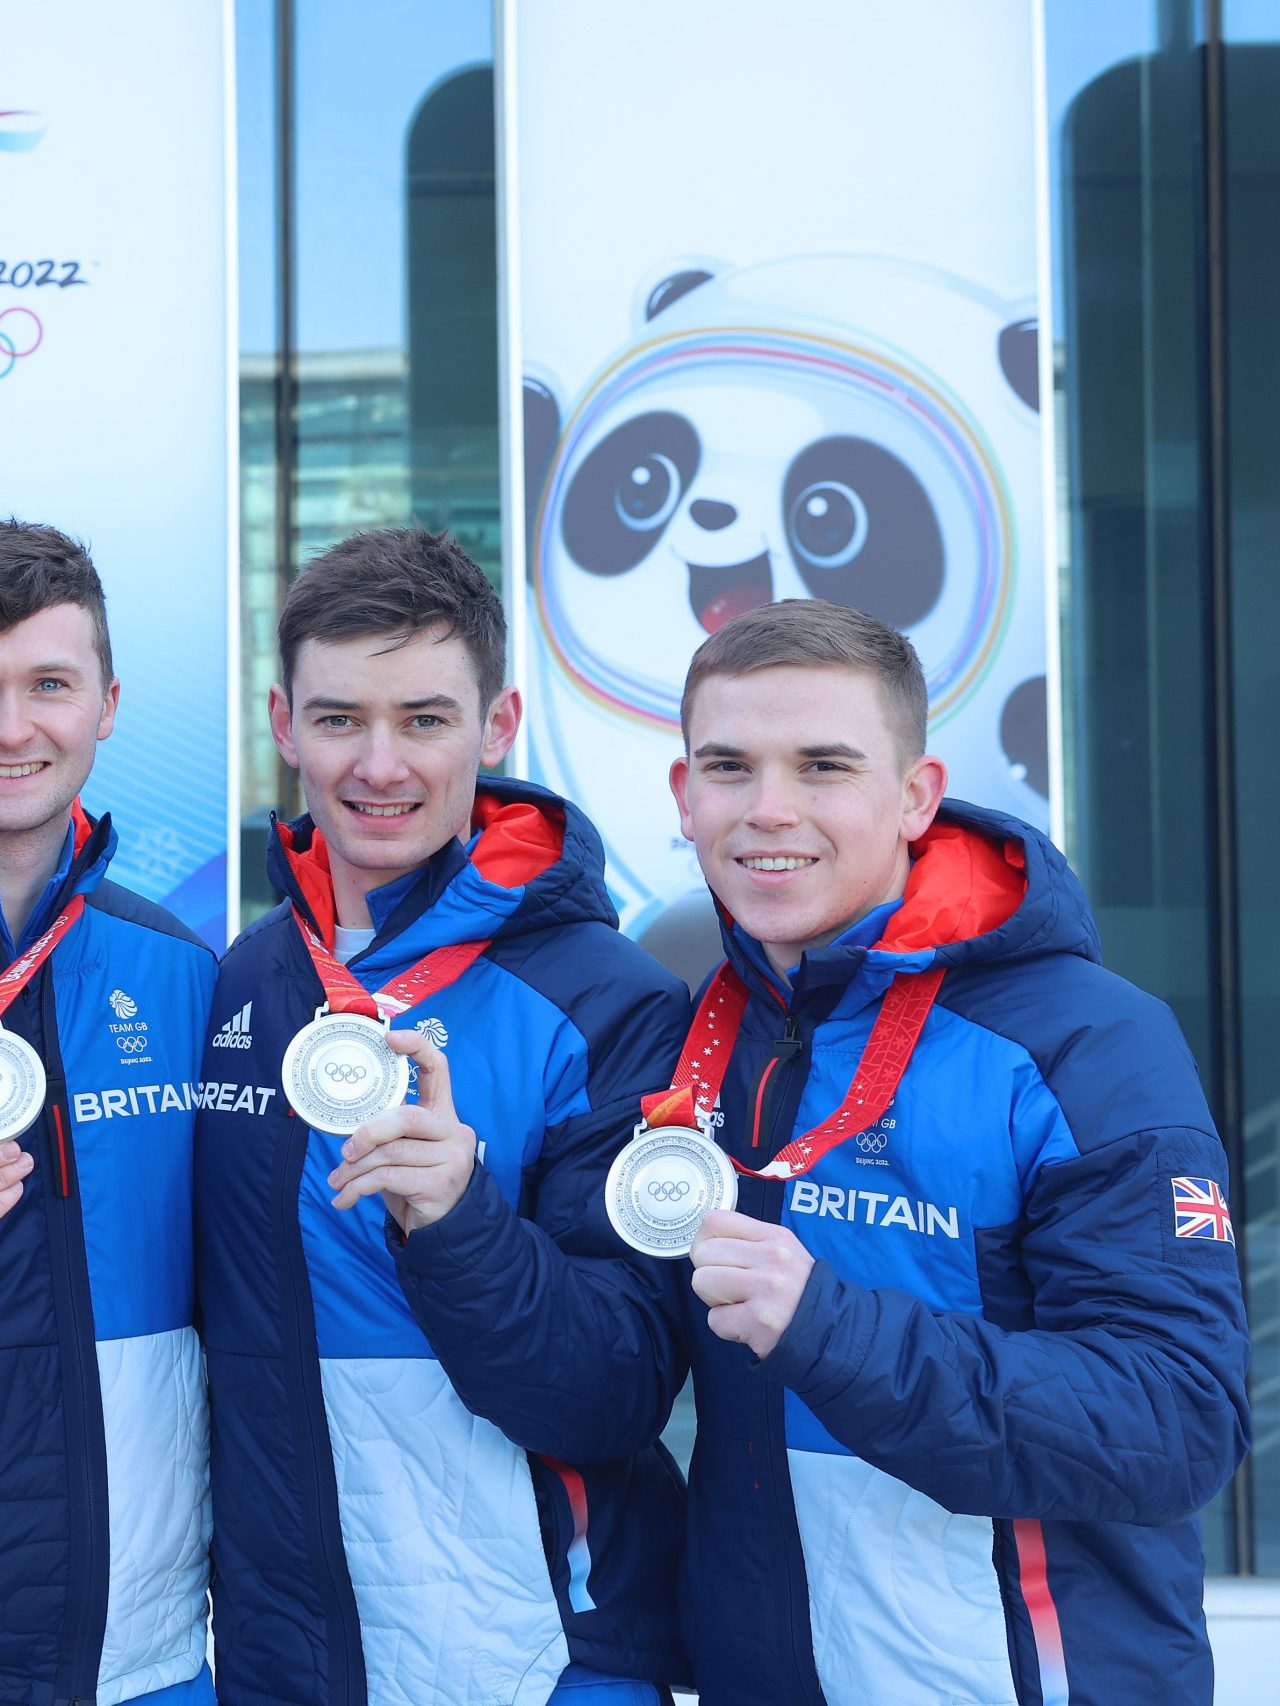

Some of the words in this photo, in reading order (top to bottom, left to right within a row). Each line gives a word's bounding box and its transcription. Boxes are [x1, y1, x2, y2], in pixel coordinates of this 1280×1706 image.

[108, 1023, 133, 1033] TEAM
[134, 1022, 148, 1031] GB
[212, 1030, 252, 1049] adidas
[881, 1118, 896, 1129] GB
[789, 1180, 960, 1239] BRITAIN
